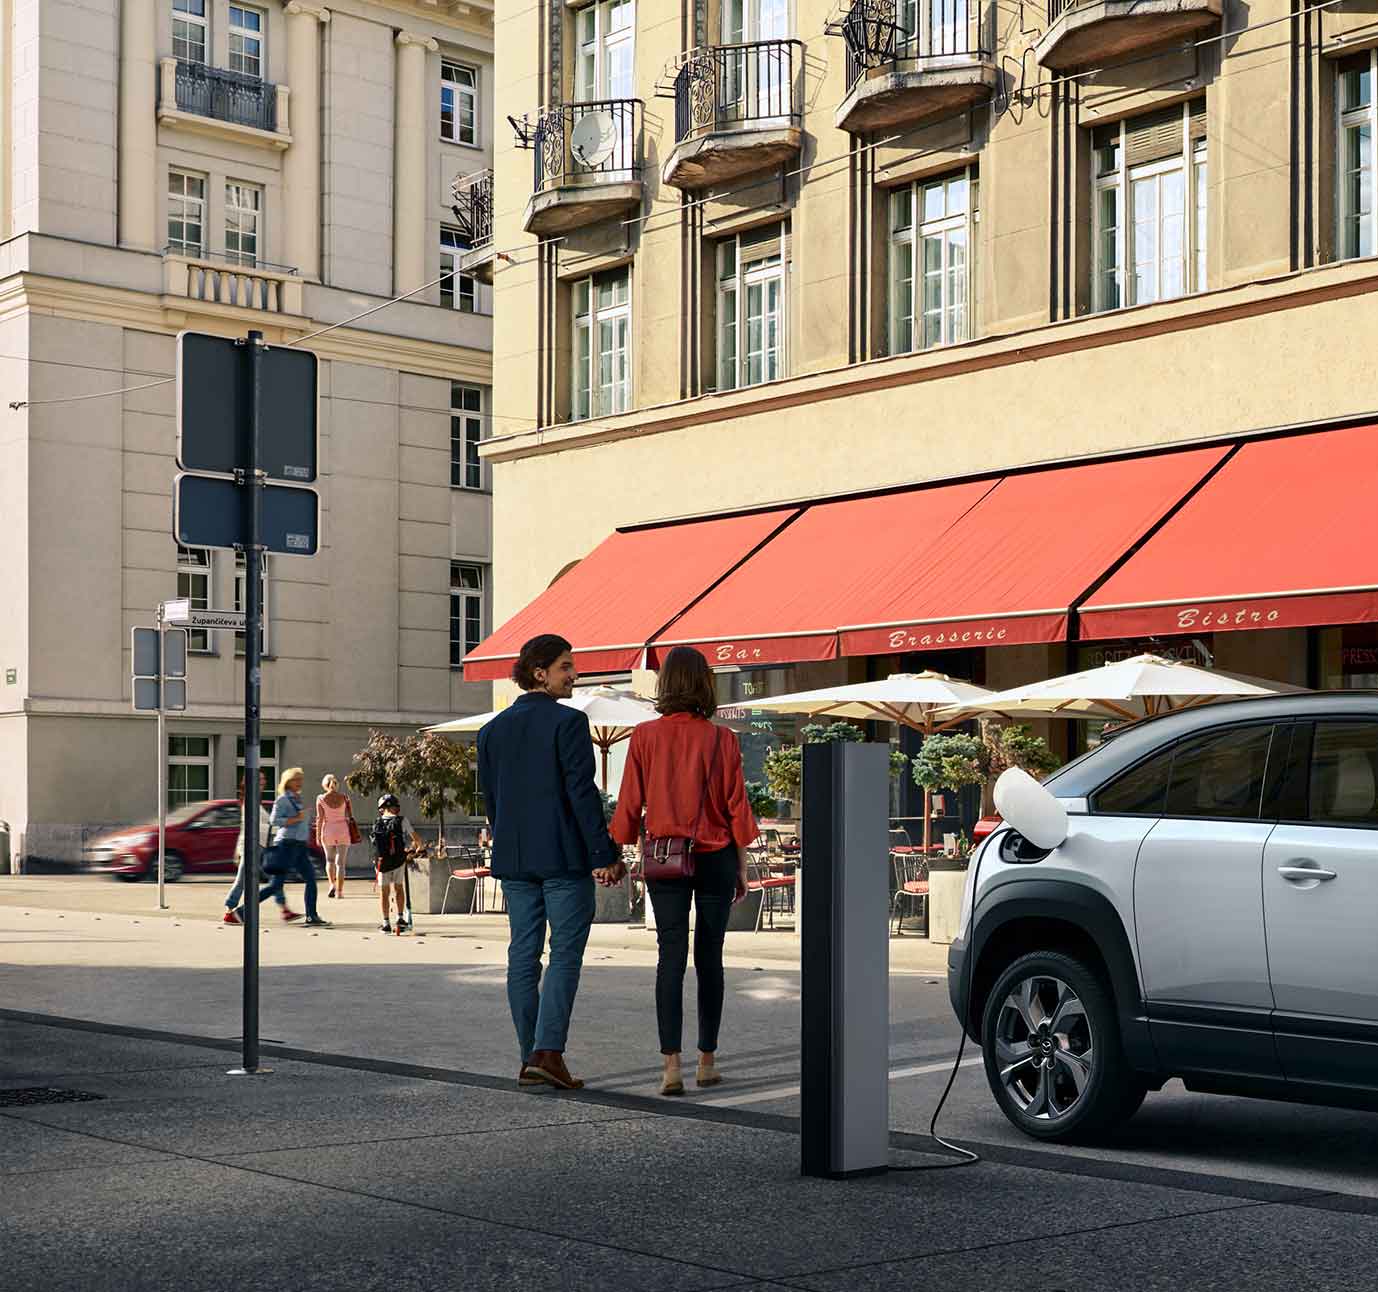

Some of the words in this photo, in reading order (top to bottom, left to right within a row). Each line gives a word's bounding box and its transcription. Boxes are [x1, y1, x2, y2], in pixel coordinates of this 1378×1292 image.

[1176, 608, 1281, 628] Bistro
[887, 626, 1007, 648] Brasserie
[715, 644, 761, 661] Bar
